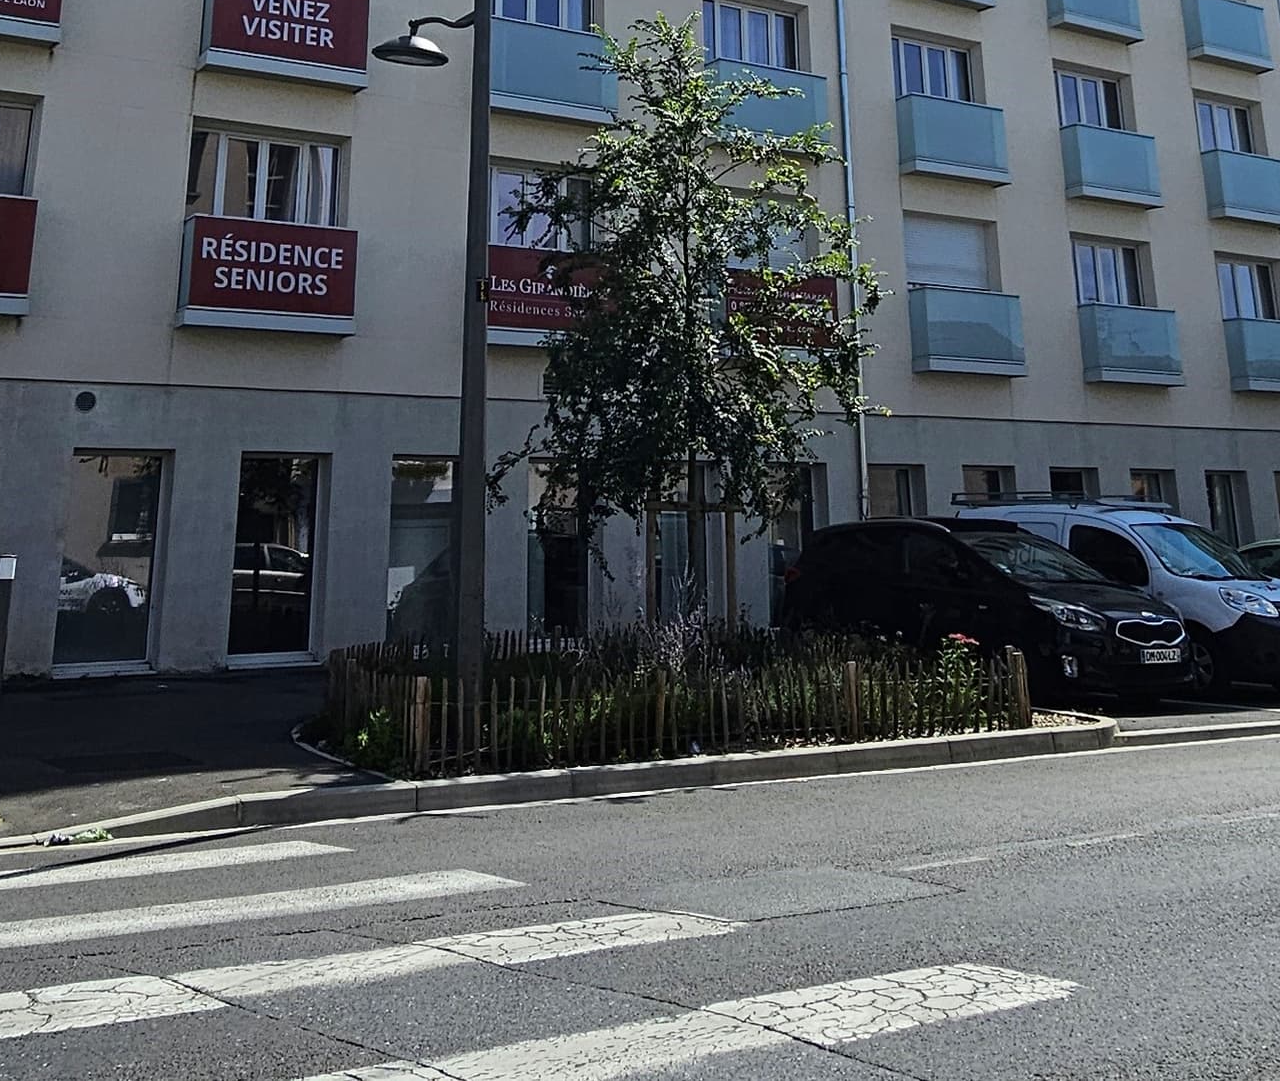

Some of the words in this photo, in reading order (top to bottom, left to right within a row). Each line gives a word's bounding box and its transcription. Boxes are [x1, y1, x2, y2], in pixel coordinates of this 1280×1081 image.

[242, 15, 334, 48] VISITER
[201, 233, 344, 270] RÉSIDENCE
[214, 266, 328, 296] SENIORS
[490, 275, 516, 292] LES
[490, 299, 561, 317] Résidences
